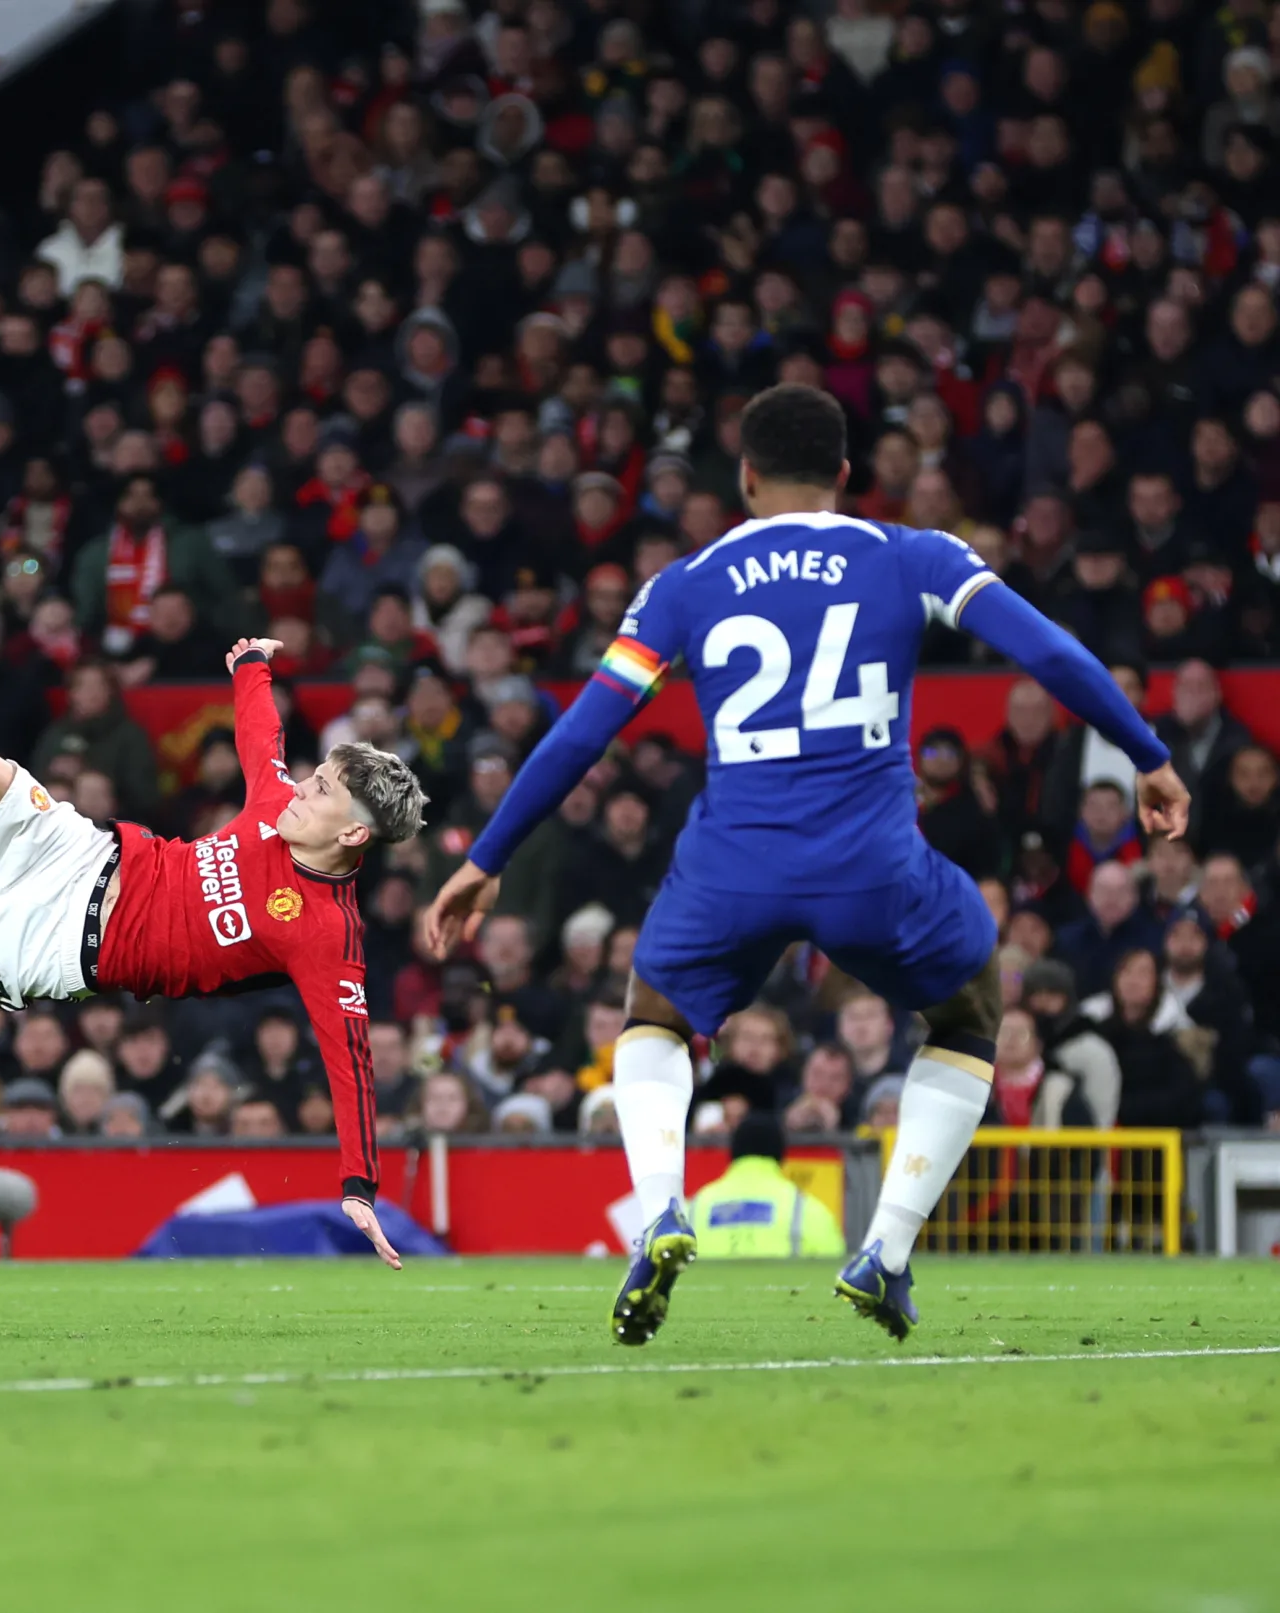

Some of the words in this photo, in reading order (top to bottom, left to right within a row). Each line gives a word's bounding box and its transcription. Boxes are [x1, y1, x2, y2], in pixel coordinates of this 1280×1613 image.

[727, 550, 848, 595] JAMES
[702, 602, 899, 764] 24
[96, 876, 108, 888] CR7
[215, 834, 243, 903] Team
[87, 902, 99, 917] CR7
[87, 933, 98, 948] CR7
